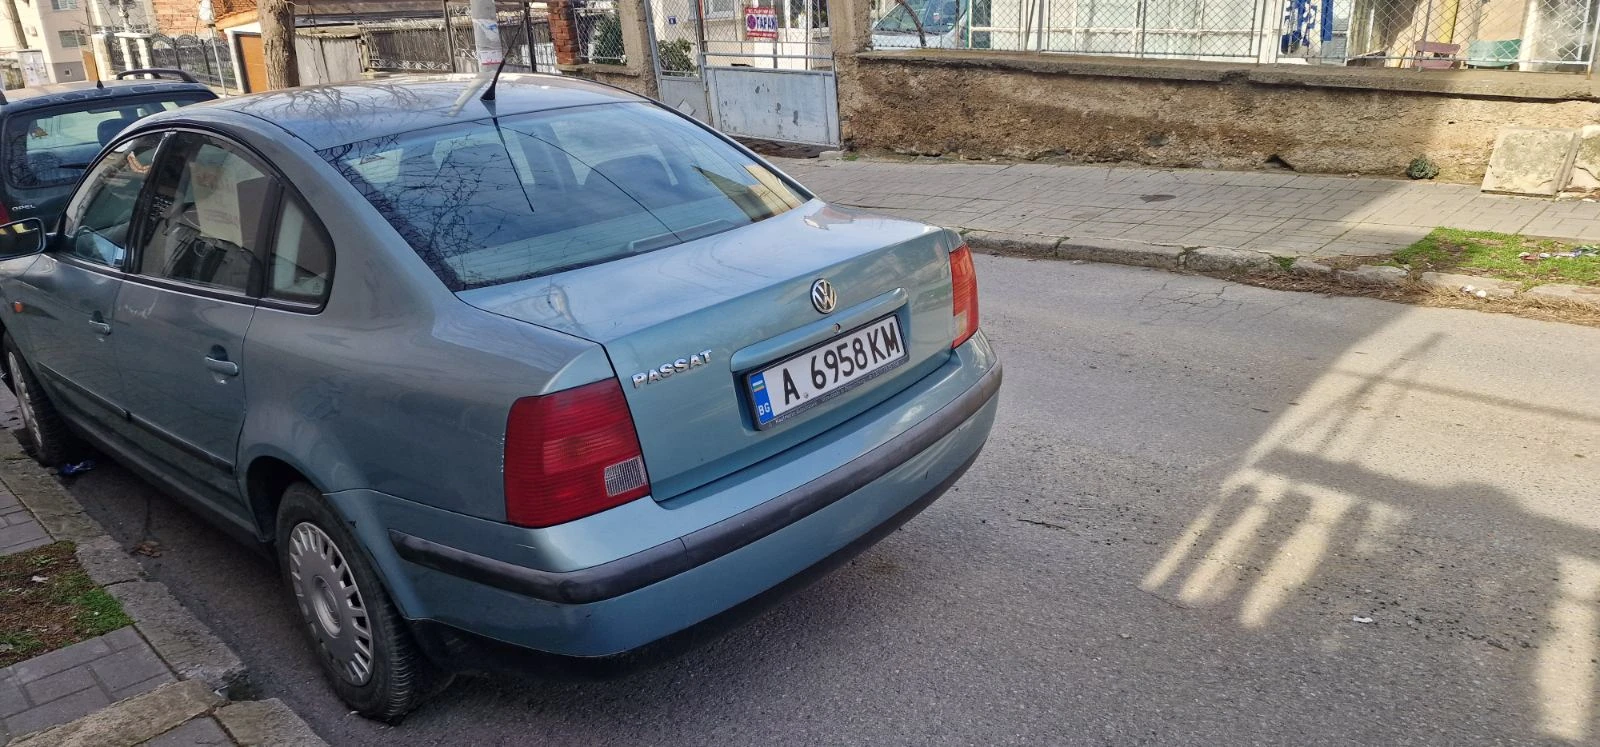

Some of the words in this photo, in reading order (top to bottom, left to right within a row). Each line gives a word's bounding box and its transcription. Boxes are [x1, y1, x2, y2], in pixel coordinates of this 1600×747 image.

[11, 204, 36, 212] OPEL
[631, 350, 712, 389] PASSAT
[783, 368, 801, 405] A
[810, 337, 868, 390] 6958
[867, 322, 900, 364] KM
[758, 402, 771, 416] BG
